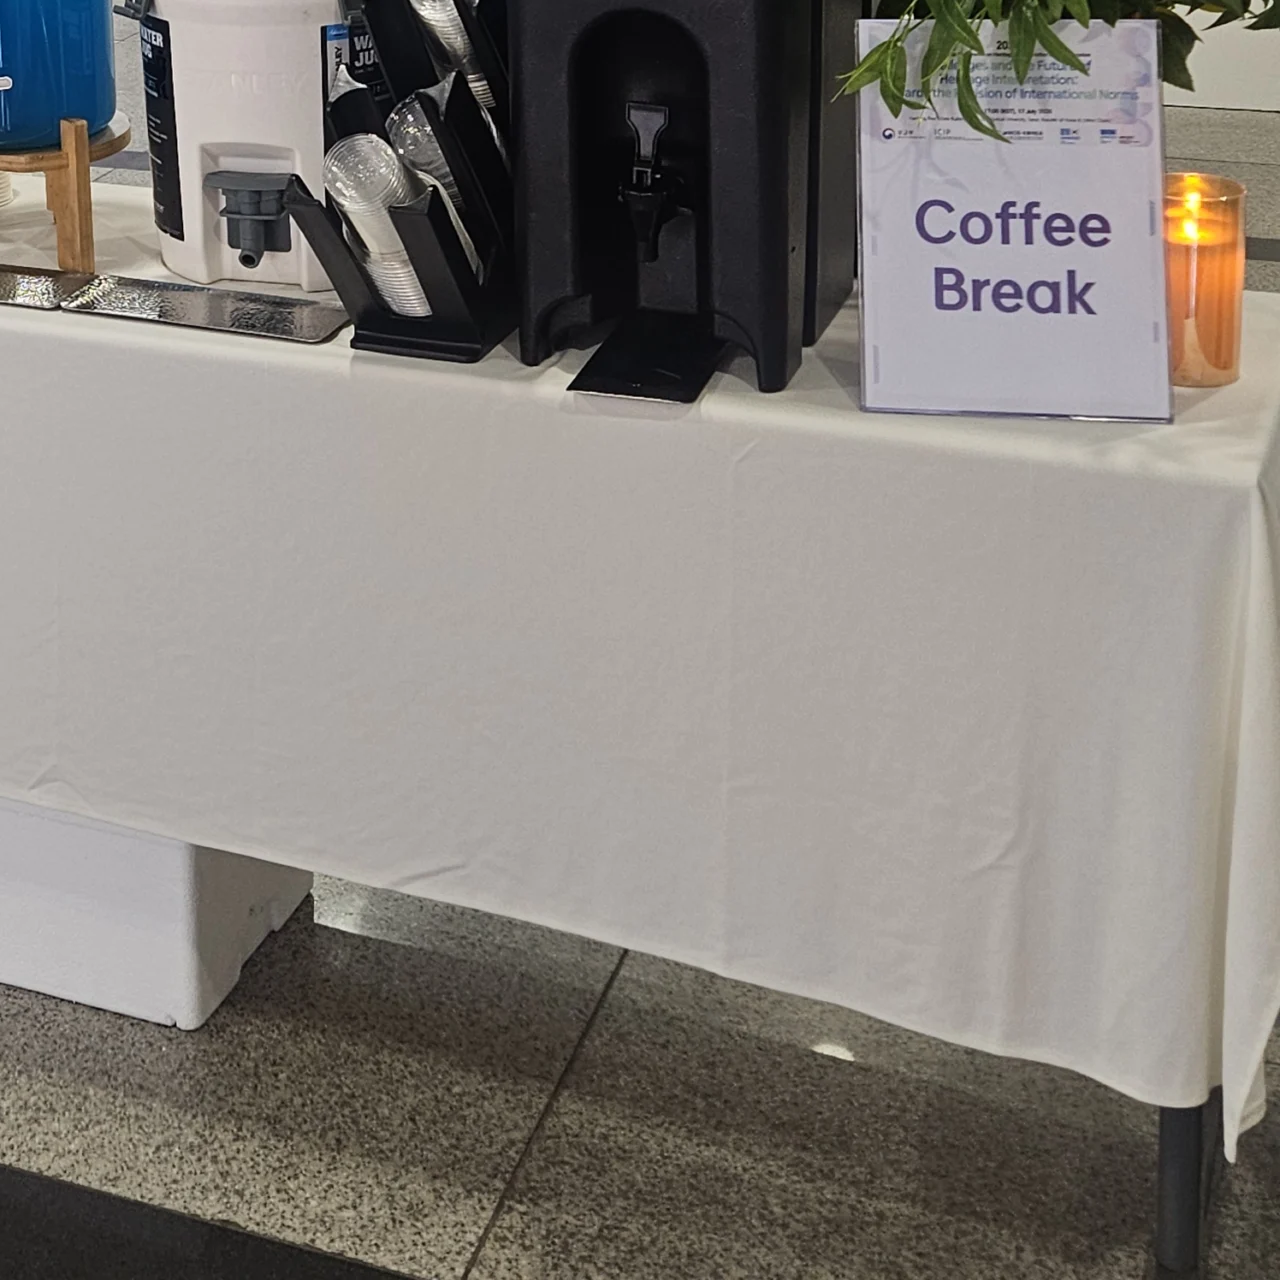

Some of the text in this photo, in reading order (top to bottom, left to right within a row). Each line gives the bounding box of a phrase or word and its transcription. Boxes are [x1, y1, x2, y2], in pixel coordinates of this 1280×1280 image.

[1005, 88, 1018, 99] of
[1020, 88, 1096, 99] International
[915, 199, 1112, 248] Coffee
[934, 267, 1098, 316] Break
